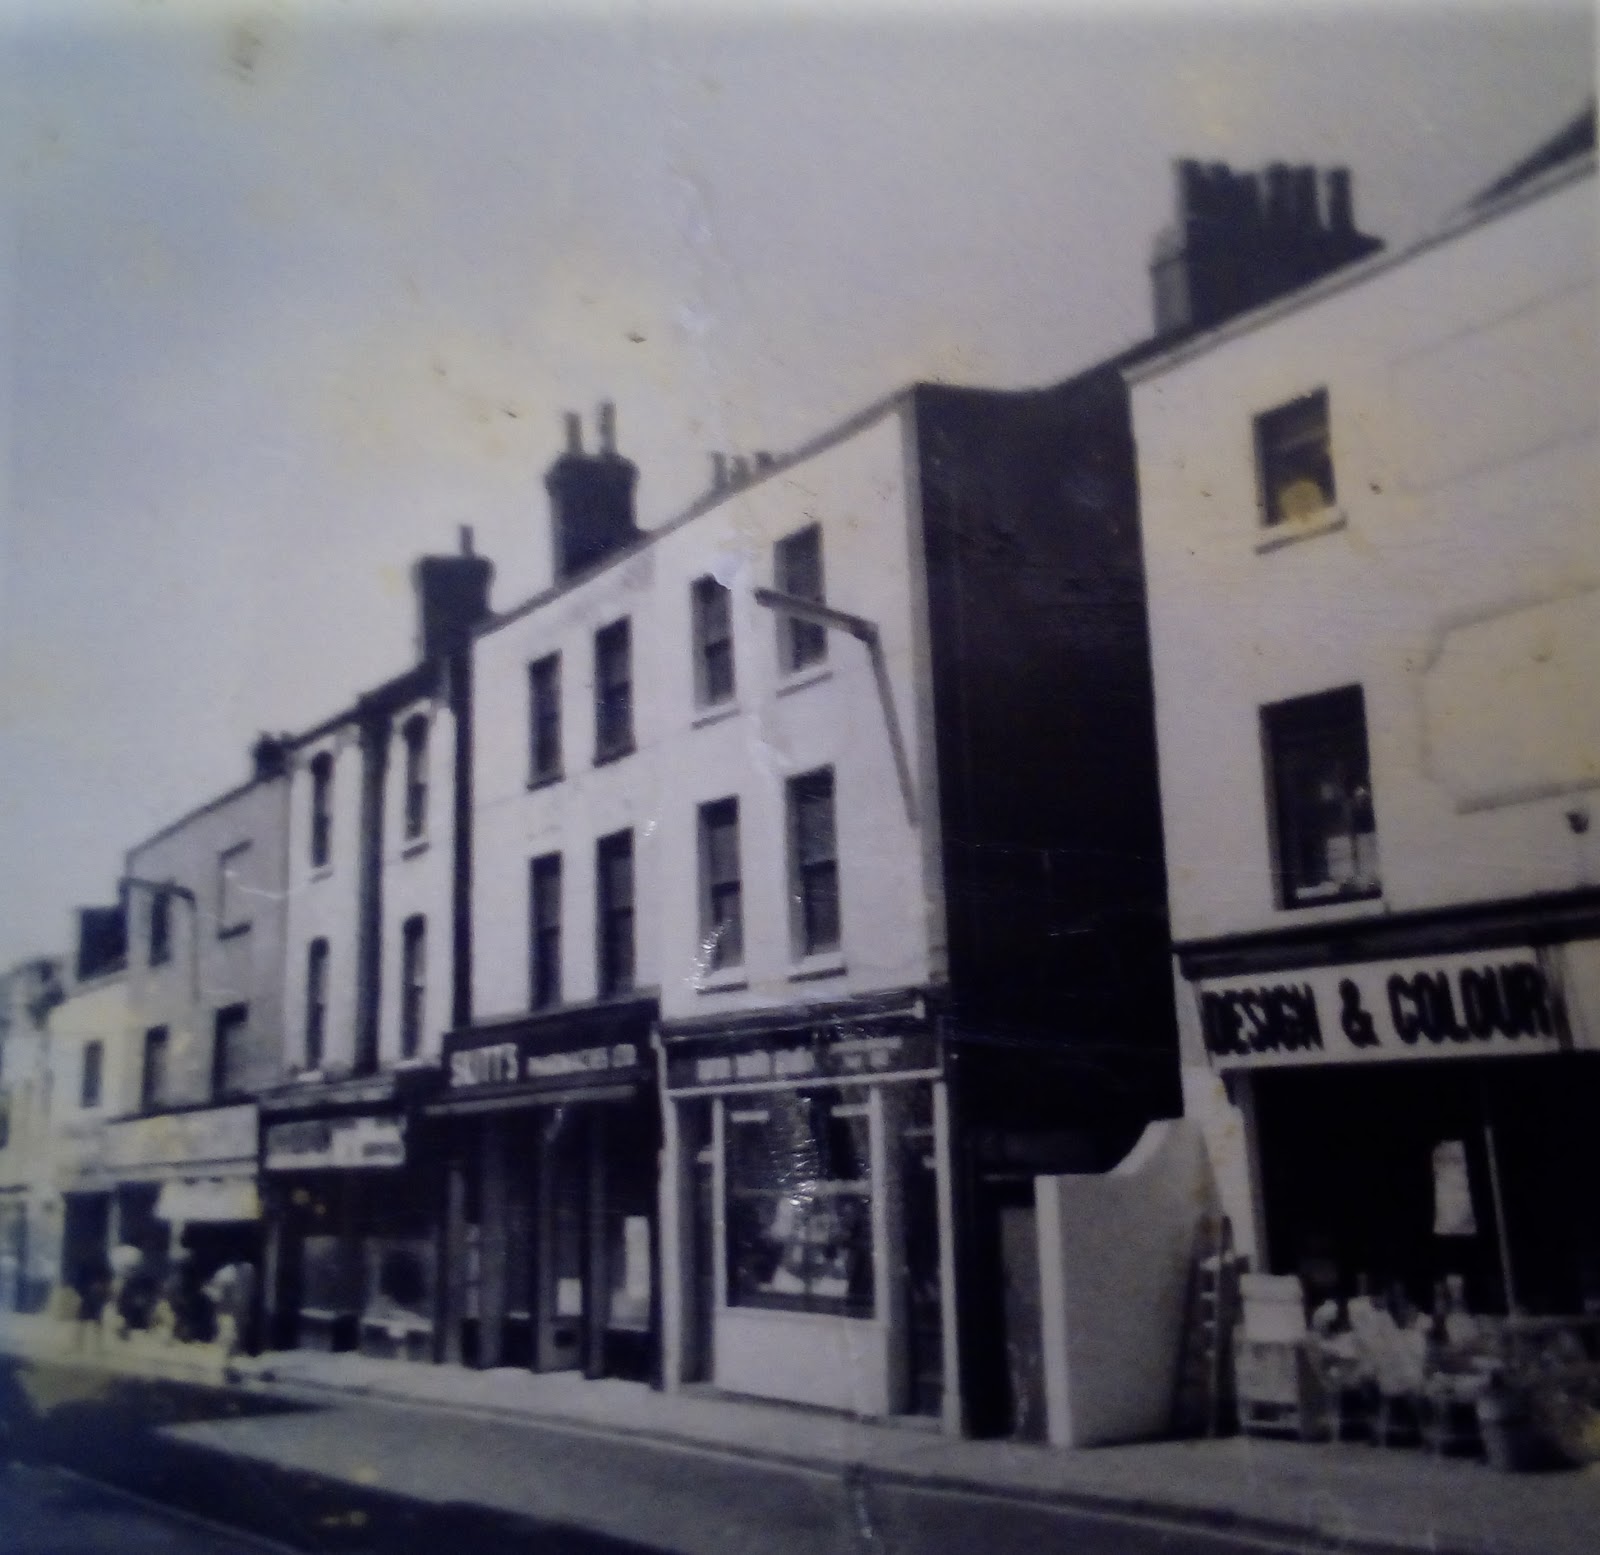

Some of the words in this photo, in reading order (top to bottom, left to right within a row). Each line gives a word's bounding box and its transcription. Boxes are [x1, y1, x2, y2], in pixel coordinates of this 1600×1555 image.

[1202, 983, 1324, 1055] DESIGN
[1339, 979, 1380, 1047] &
[1388, 962, 1556, 1044] COLOUR
